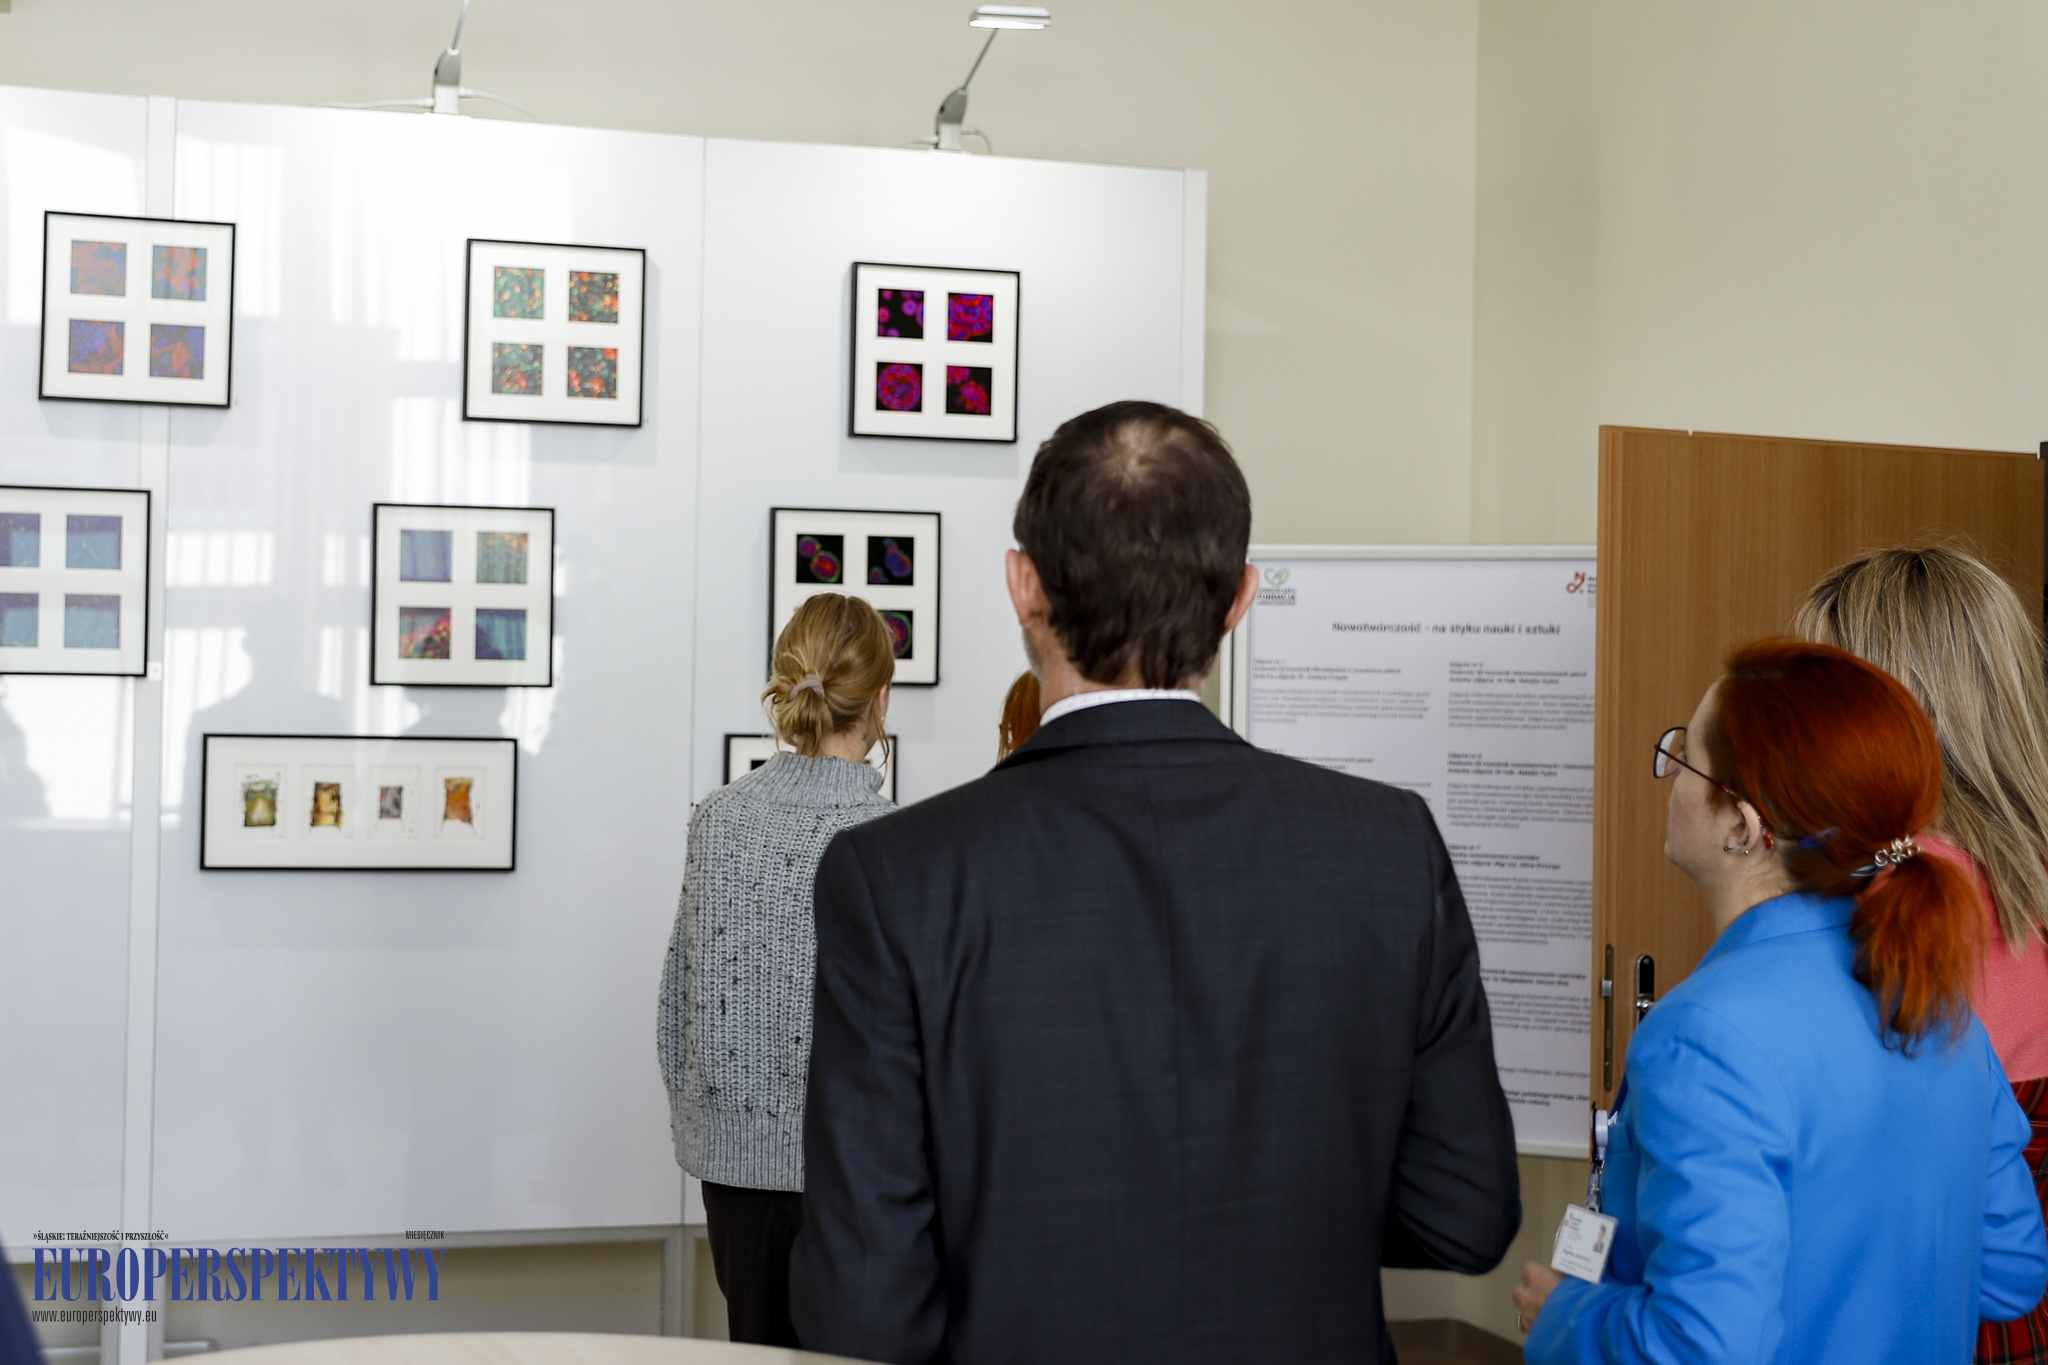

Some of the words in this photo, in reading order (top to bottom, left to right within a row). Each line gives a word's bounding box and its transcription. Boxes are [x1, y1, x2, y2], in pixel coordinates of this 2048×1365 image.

[1432, 625, 1446, 633] na
[1450, 623, 1481, 636] styku
[1483, 623, 1515, 634] nauki
[1525, 624, 1561, 635] sztuki
